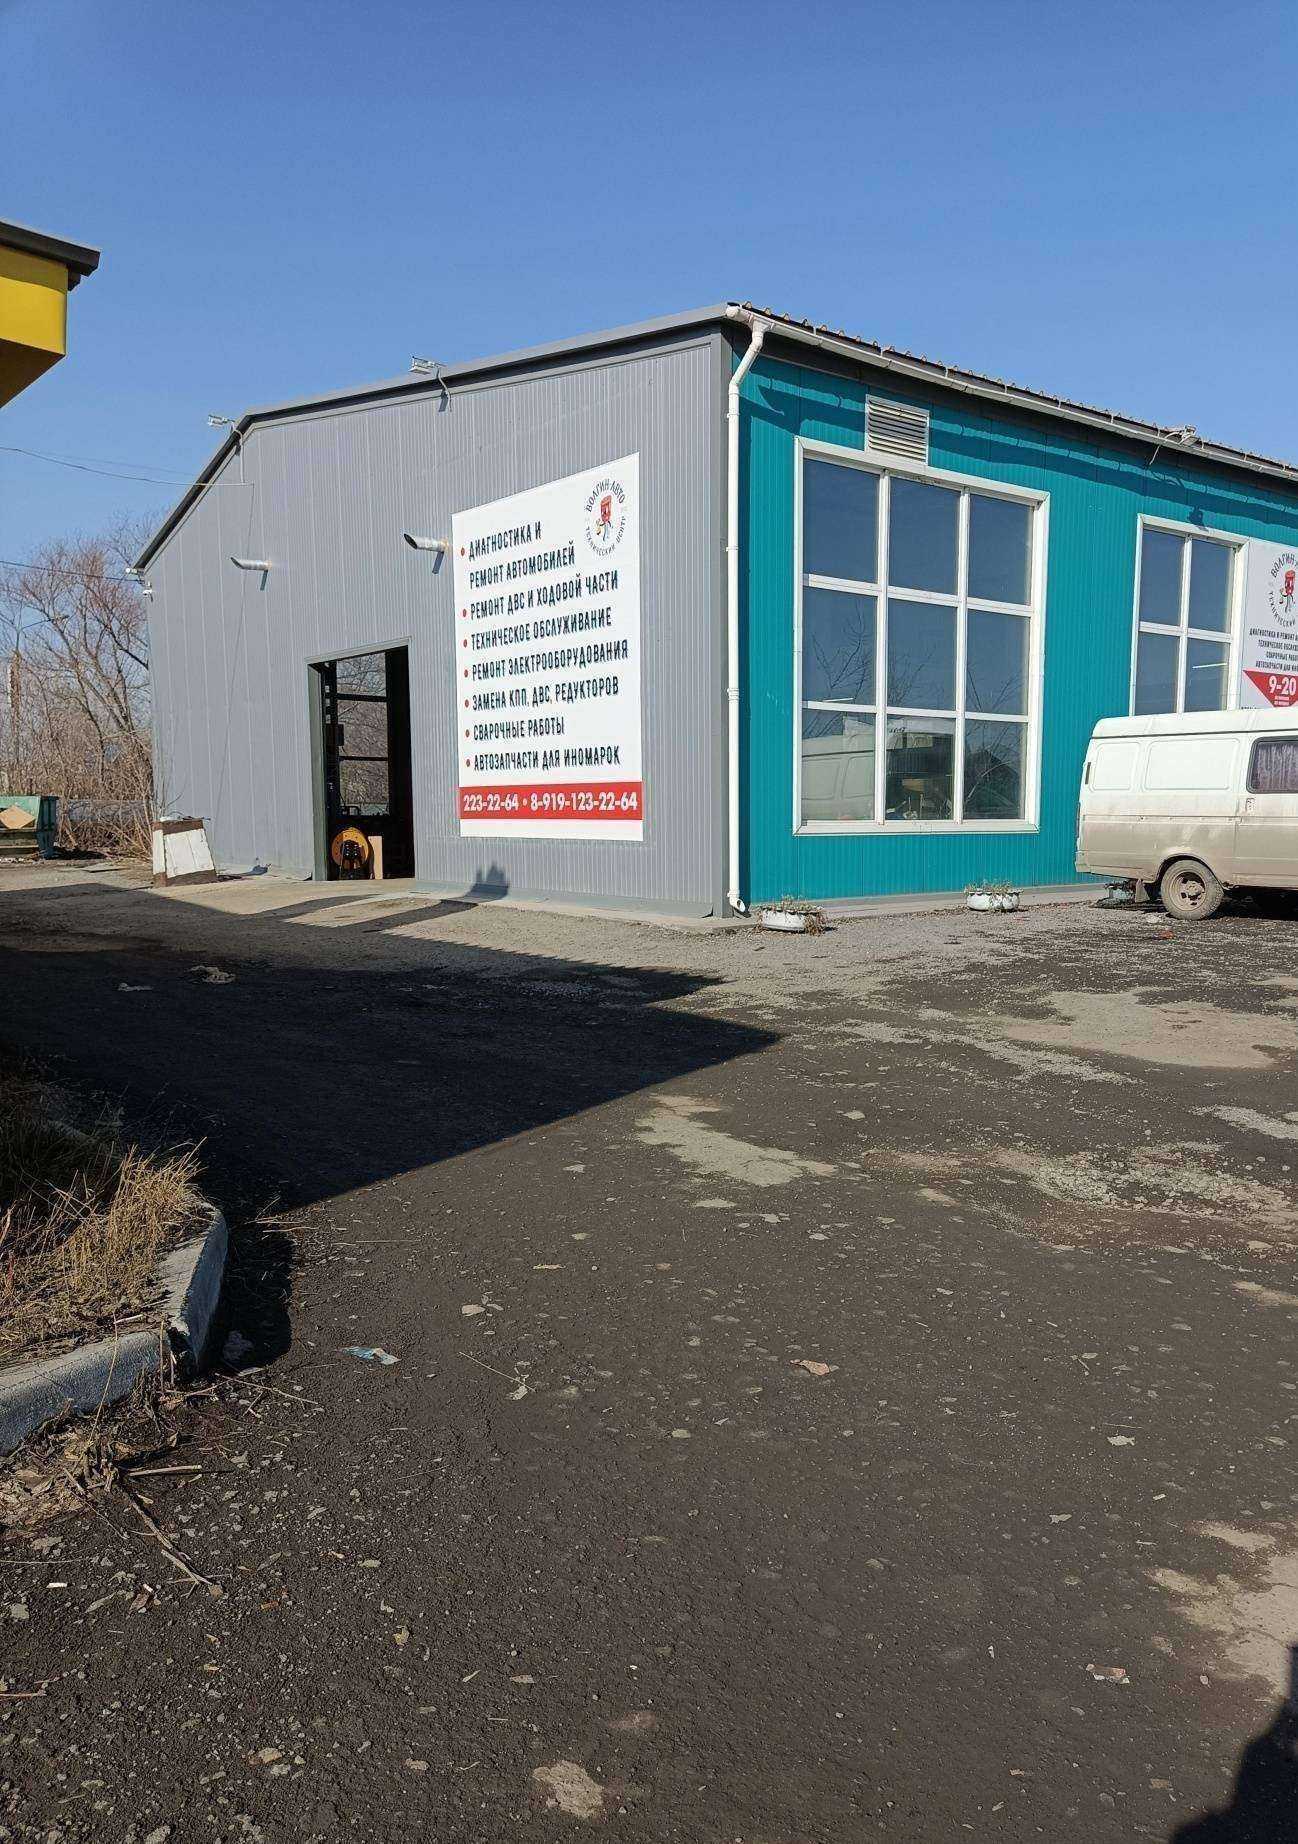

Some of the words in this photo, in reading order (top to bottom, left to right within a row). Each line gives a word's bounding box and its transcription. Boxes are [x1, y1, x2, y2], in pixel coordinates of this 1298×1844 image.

[469, 524, 532, 561] ДИАГНОСТИКА
[536, 521, 541, 540] И
[470, 564, 503, 589] РЕМОНТ
[506, 540, 575, 581] АВТОМОБИЛЕЙ
[471, 594, 504, 620] РЕМОНТ
[507, 592, 525, 615] ДВС
[528, 590, 533, 608] И
[537, 573, 582, 606] ХОДОВОЙ
[586, 570, 618, 594] ЧАСТИ
[471, 623, 530, 651] ТЕХНИЧЕСКОЕ
[533, 607, 612, 639] ОБСЛУЖИВАНИЕ
[472, 660, 505, 681] РЕМОНТ
[508, 639, 628, 676] ЭЛЕКТРООБОРУДОВАНИЯ
[472, 691, 506, 711] ЗАМЕНА
[555, 676, 619, 703] РЕДУКТОРОВ
[473, 720, 525, 741] СВАРОЧНЫЕ
[528, 716, 565, 738] РАБОТЫ
[474, 751, 539, 771] АВТОЗАПЧАСТИ
[542, 750, 560, 770] ДЛЯ
[564, 745, 620, 767] ИНОМАРОК
[463, 793, 519, 812] 223-22-64
[530, 791, 637, 812] 8-919-123-22-64
